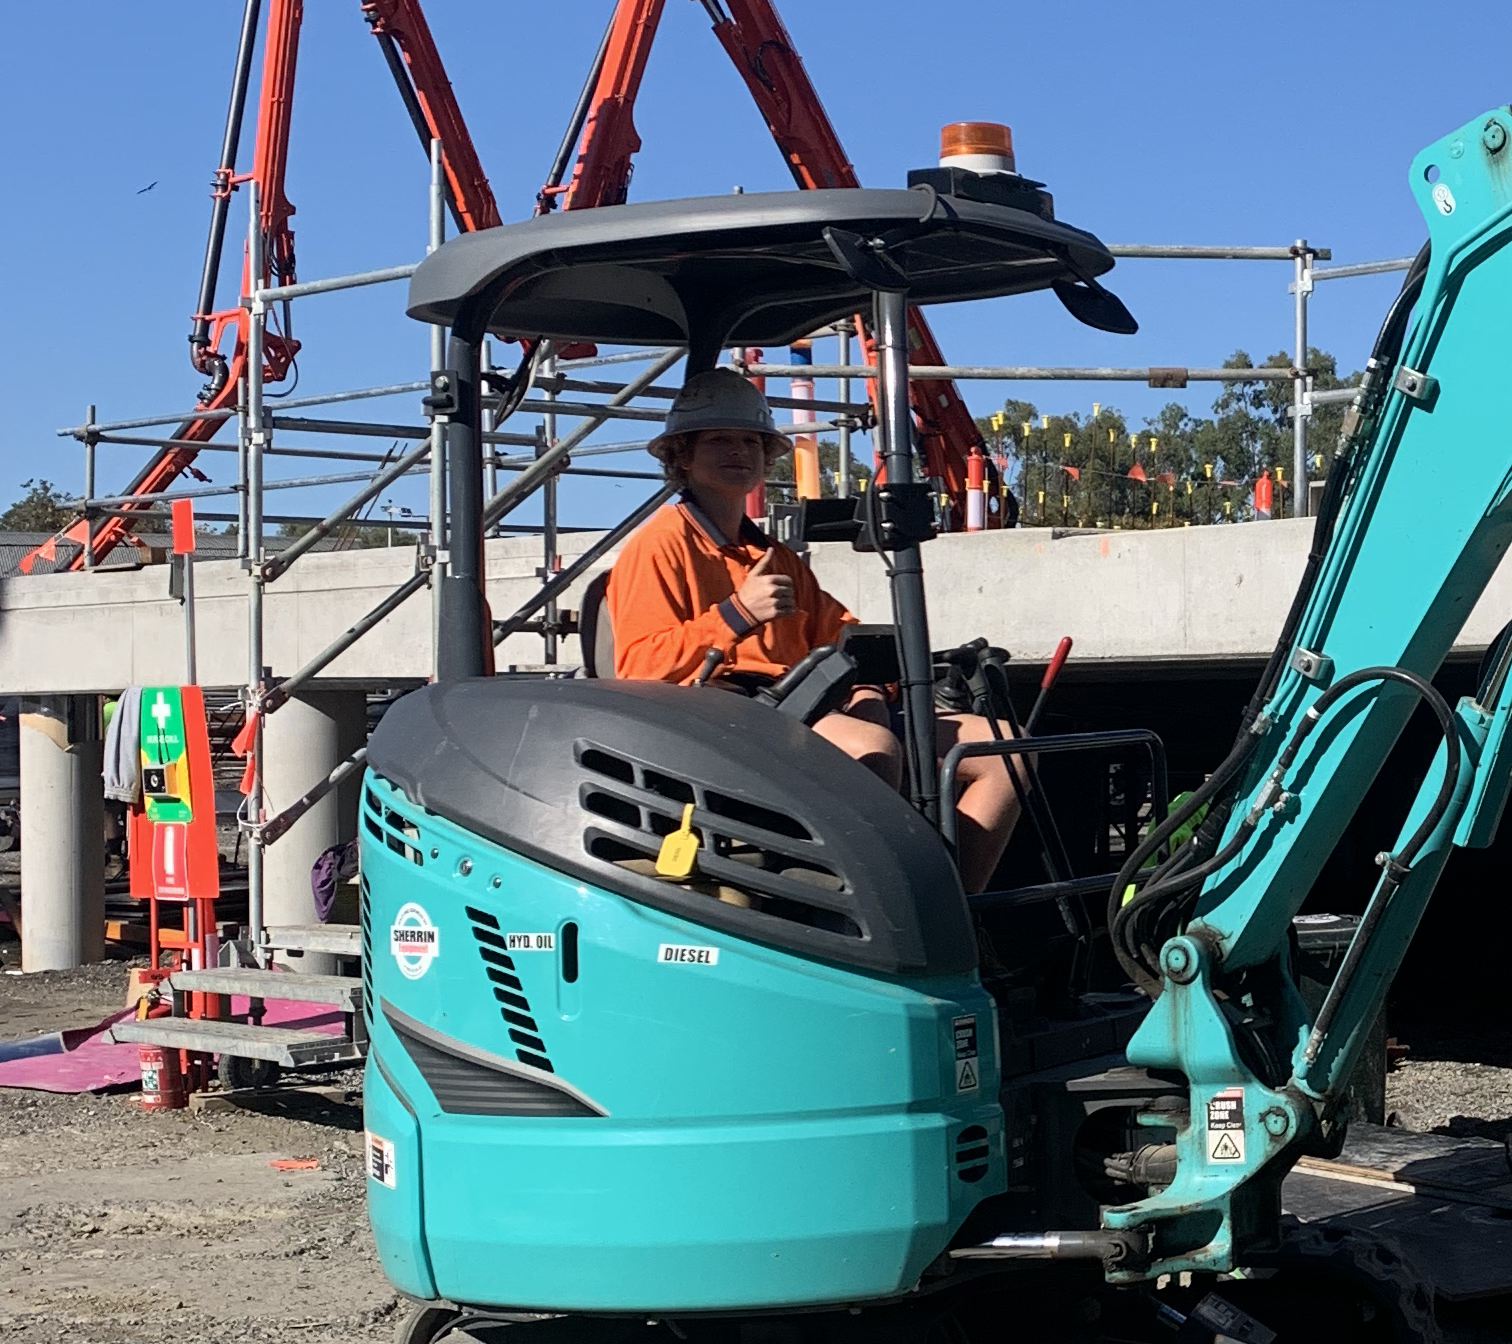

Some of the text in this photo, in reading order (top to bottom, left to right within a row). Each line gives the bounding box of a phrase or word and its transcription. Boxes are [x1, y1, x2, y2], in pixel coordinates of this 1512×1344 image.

[393, 929, 435, 943] SHERRIN
[508, 934, 554, 949] HYD. OIL
[663, 947, 712, 964] DIESEL
[1209, 1100, 1237, 1110] CRUSH
[1209, 1110, 1230, 1120] ZONE
